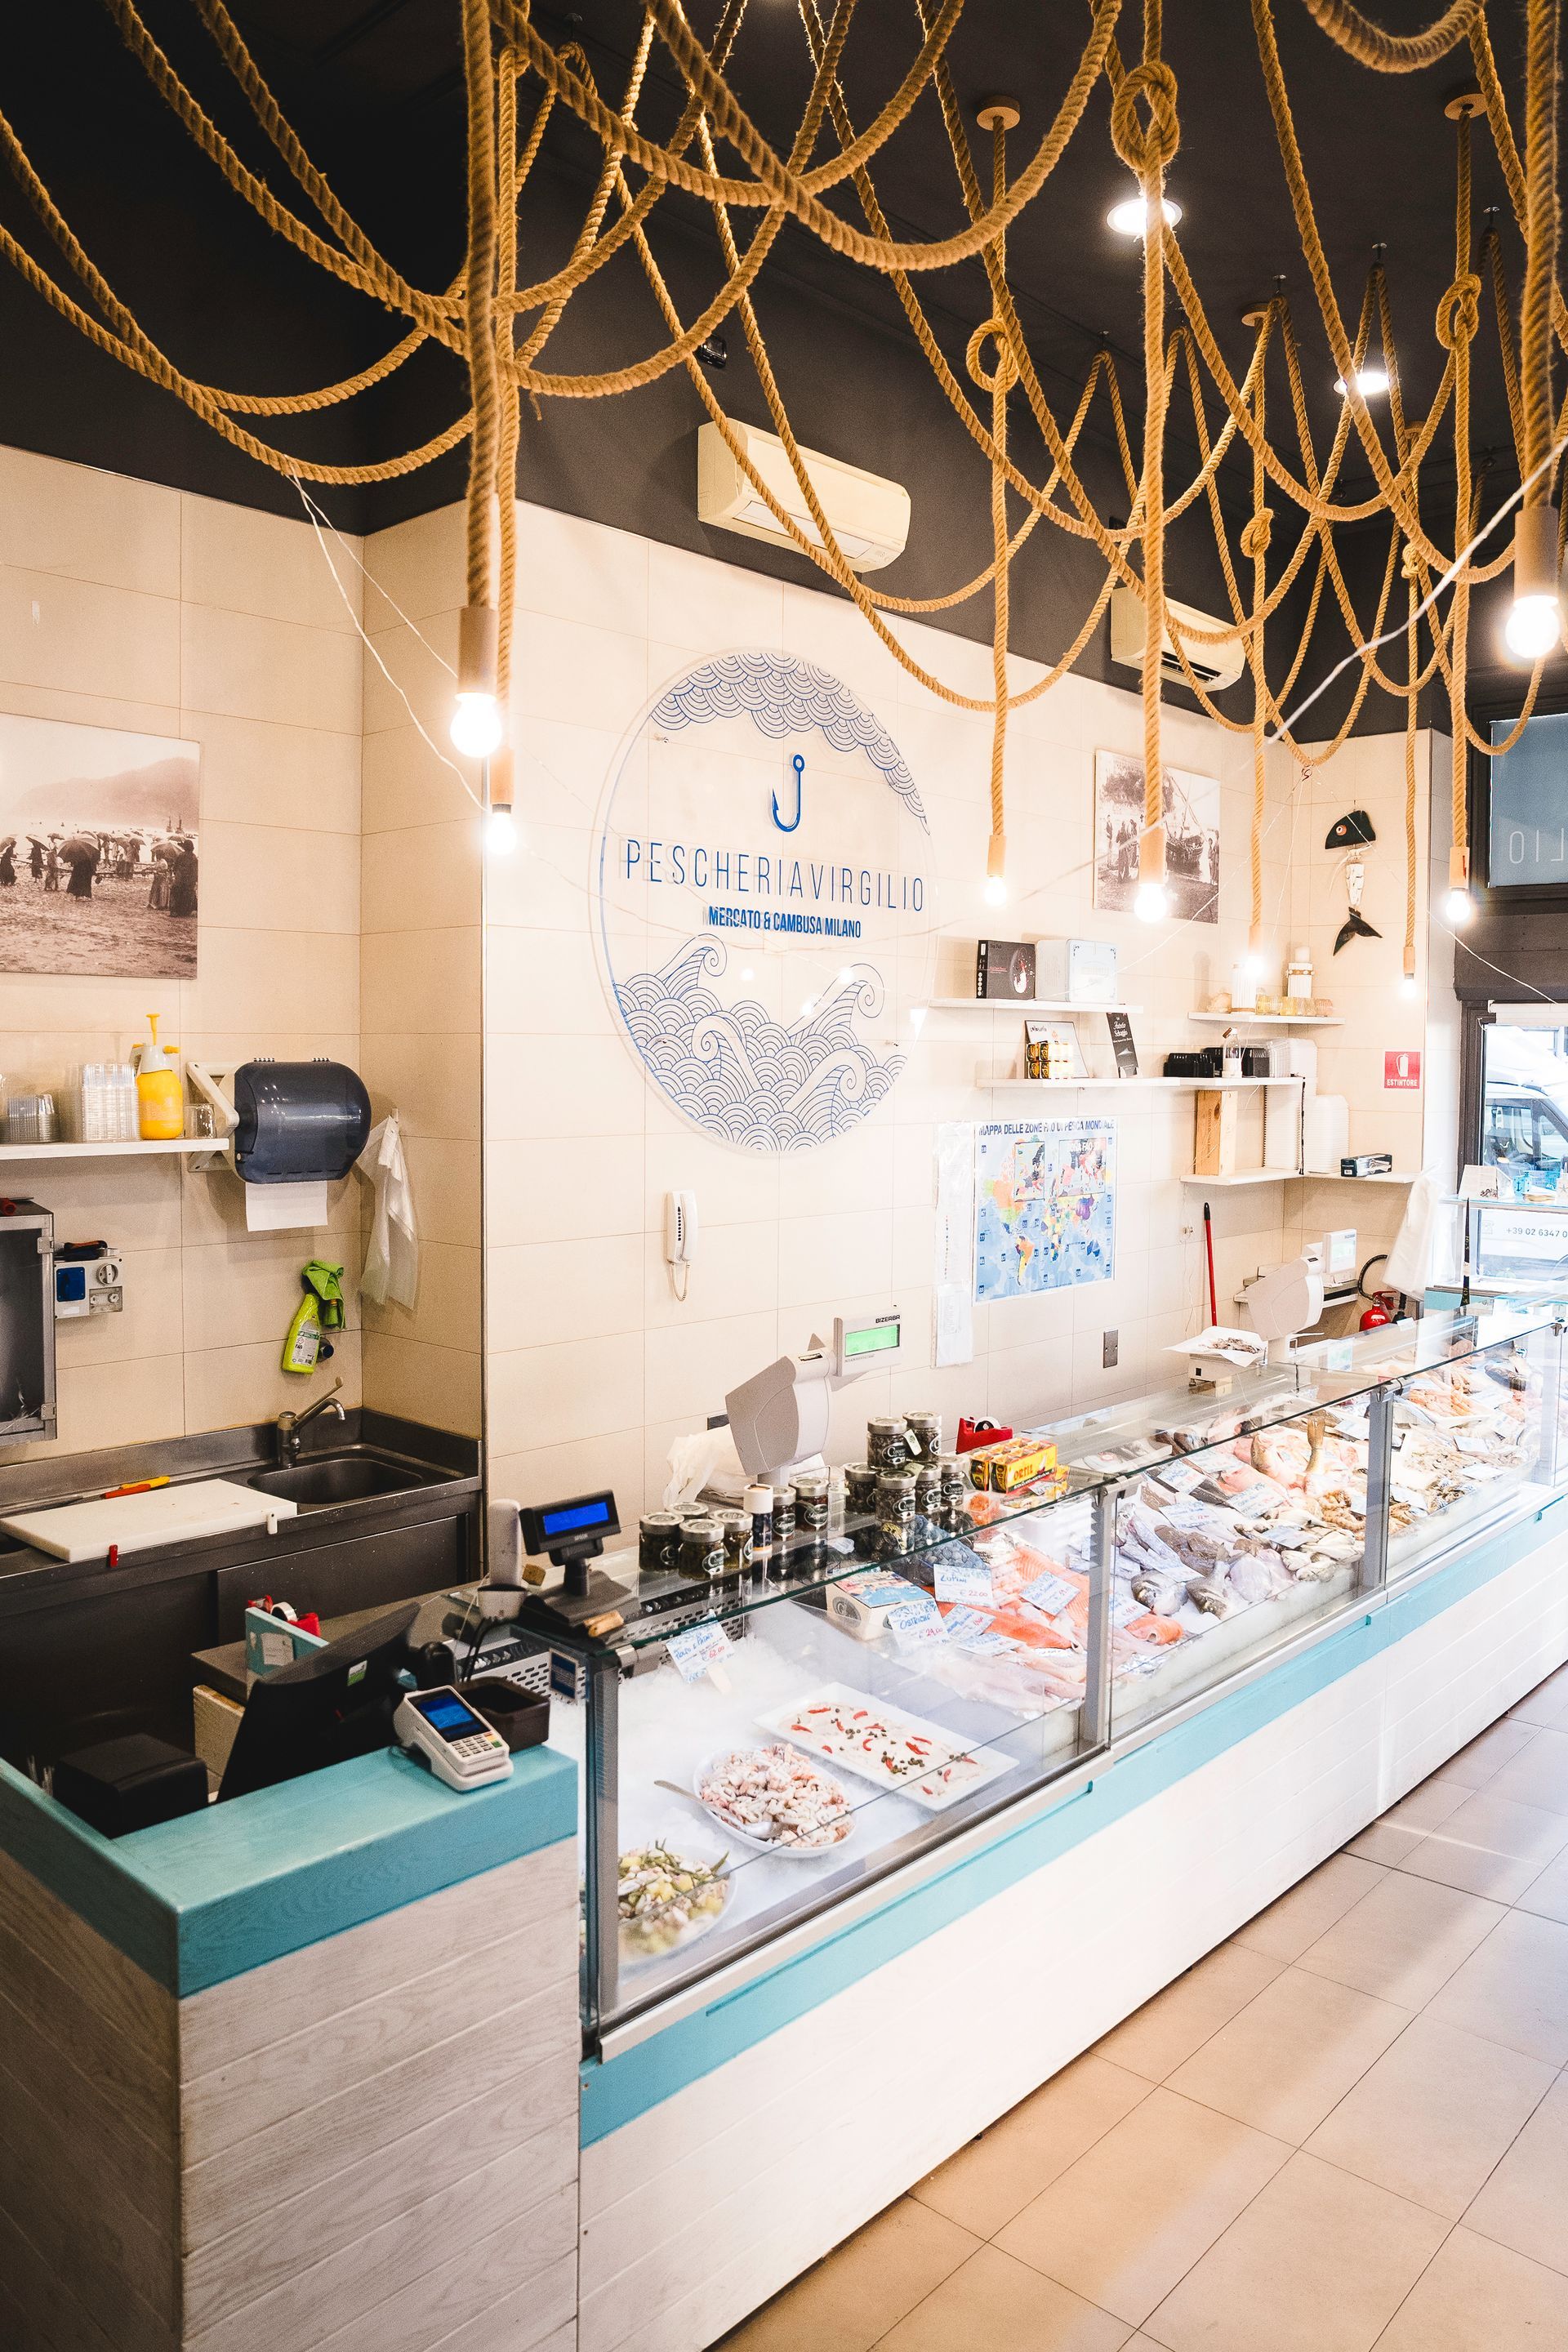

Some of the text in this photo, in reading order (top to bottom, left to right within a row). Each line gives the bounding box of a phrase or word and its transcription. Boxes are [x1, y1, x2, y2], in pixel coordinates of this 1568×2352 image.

[708, 905, 862, 938] MERCATO & CAMBUSA MILANO
[1386, 1078, 1418, 1087] ESTINTORE
[978, 1125, 1002, 1136] MAPPA
[1004, 1123, 1024, 1134] DELLE
[1025, 1122, 1043, 1134] ZONE
[1506, 1227, 1523, 1236] +39
[1525, 1228, 1535, 1236] 02
[1538, 1228, 1559, 1238] 6347
